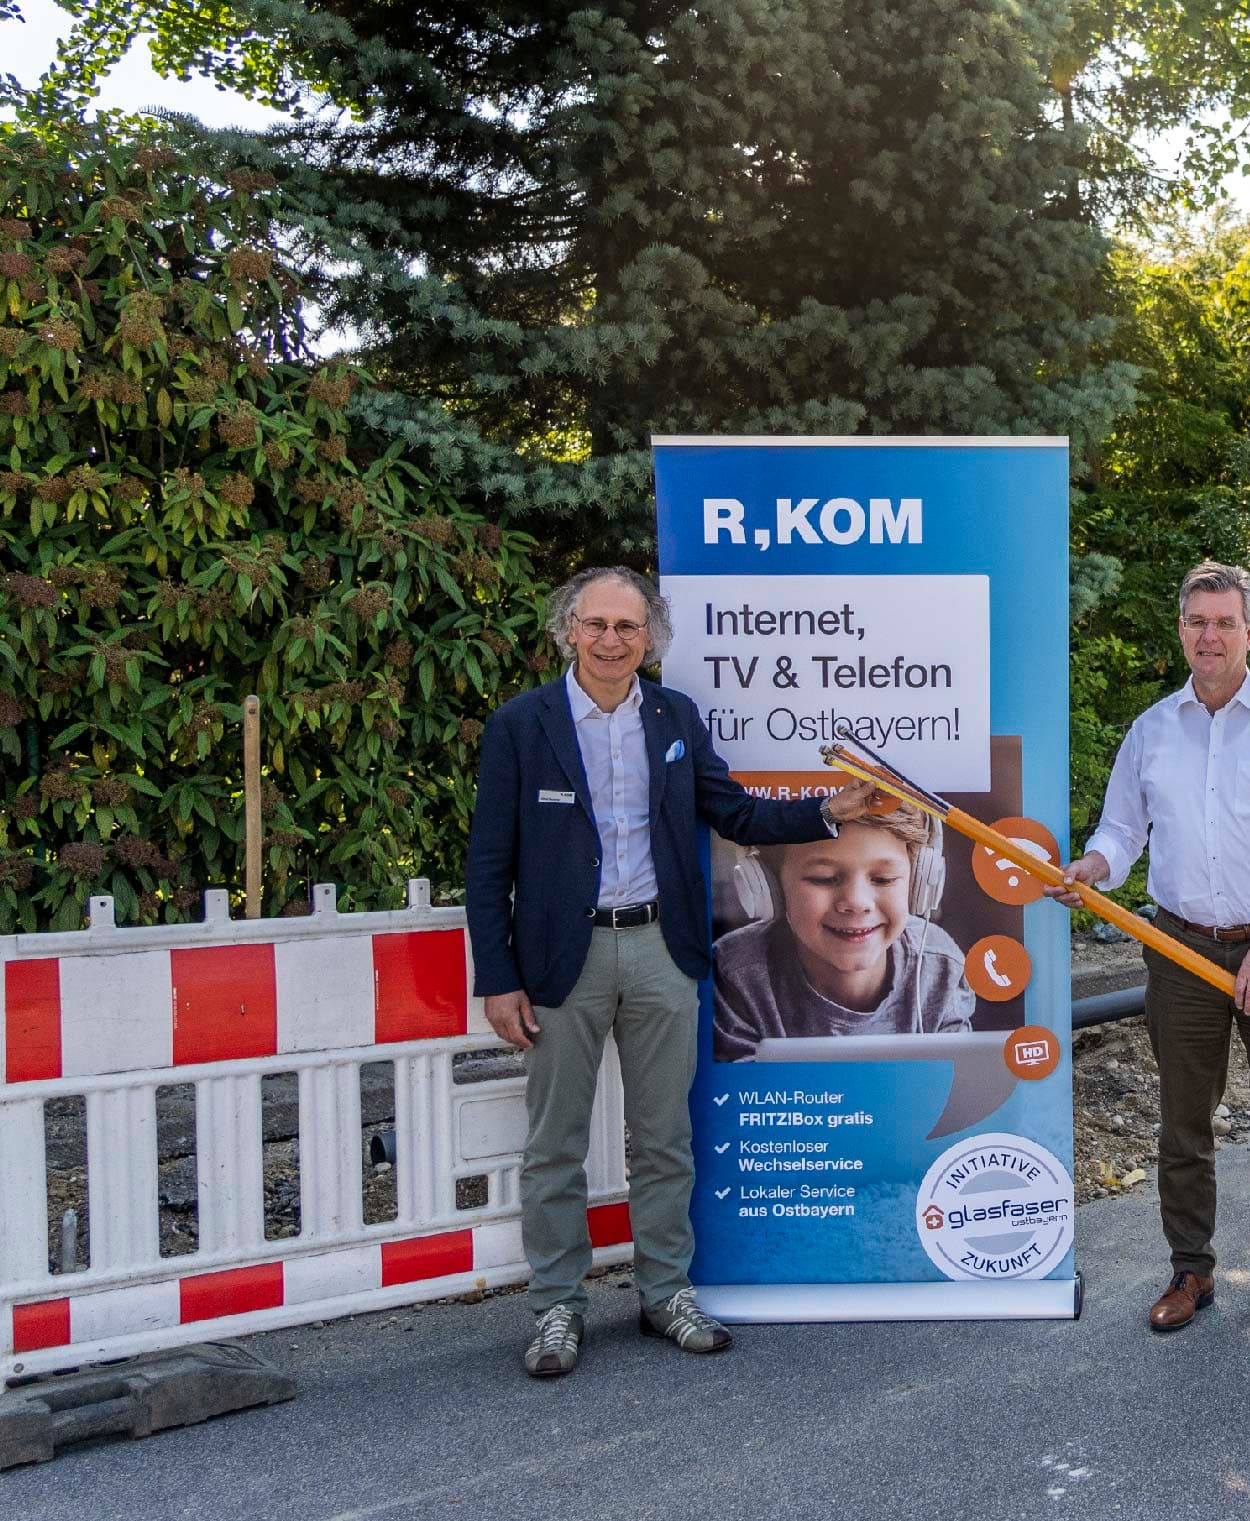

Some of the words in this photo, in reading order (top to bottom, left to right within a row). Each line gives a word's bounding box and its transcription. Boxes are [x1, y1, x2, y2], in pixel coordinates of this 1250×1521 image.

[704, 498, 923, 551] R,KOM
[706, 603, 865, 640] Internet,
[704, 656, 760, 688] TV
[772, 656, 800, 688] &
[812, 656, 952, 688] Telefon
[705, 708, 754, 741] für
[767, 707, 960, 748] Ostbayern!
[1022, 1047, 1043, 1058] HD
[738, 1091, 845, 1104] WLAN-Router
[739, 1112, 823, 1126] FRITZ!Box
[828, 1111, 873, 1127] gratis
[740, 1140, 829, 1153] Kostenloser
[738, 1158, 863, 1171] Wechselservice
[946, 1153, 1041, 1189] INITIATIVE
[740, 1185, 796, 1199] Lokaler
[800, 1184, 855, 1198] Service
[739, 1206, 767, 1217] aus
[772, 1203, 855, 1218] Ostbayern
[948, 1198, 1068, 1229] glasfaser
[961, 1242, 1042, 1274] ZUKUNFT
